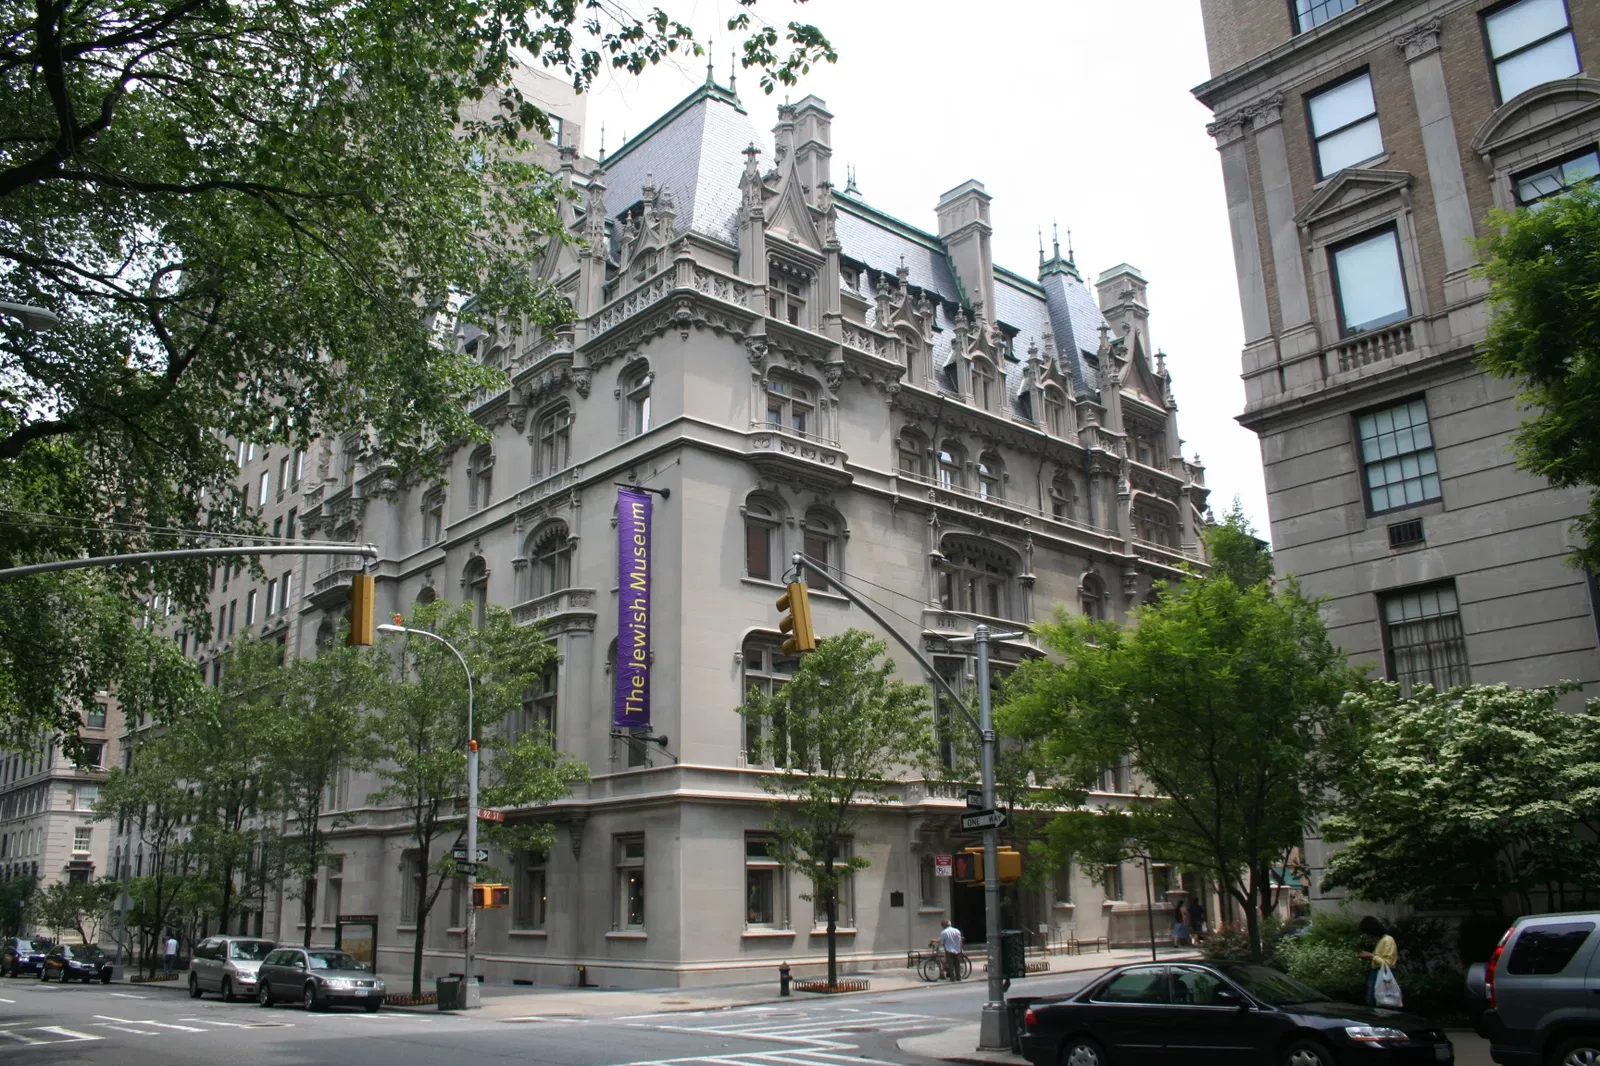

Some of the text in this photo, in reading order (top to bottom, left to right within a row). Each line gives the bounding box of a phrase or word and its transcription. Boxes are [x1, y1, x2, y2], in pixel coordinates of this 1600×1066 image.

[626, 502, 647, 715] The Jewish Museum
[971, 796, 980, 804] ONE
[484, 810, 491, 819] 92
[967, 814, 1001, 827] ONE WAY
